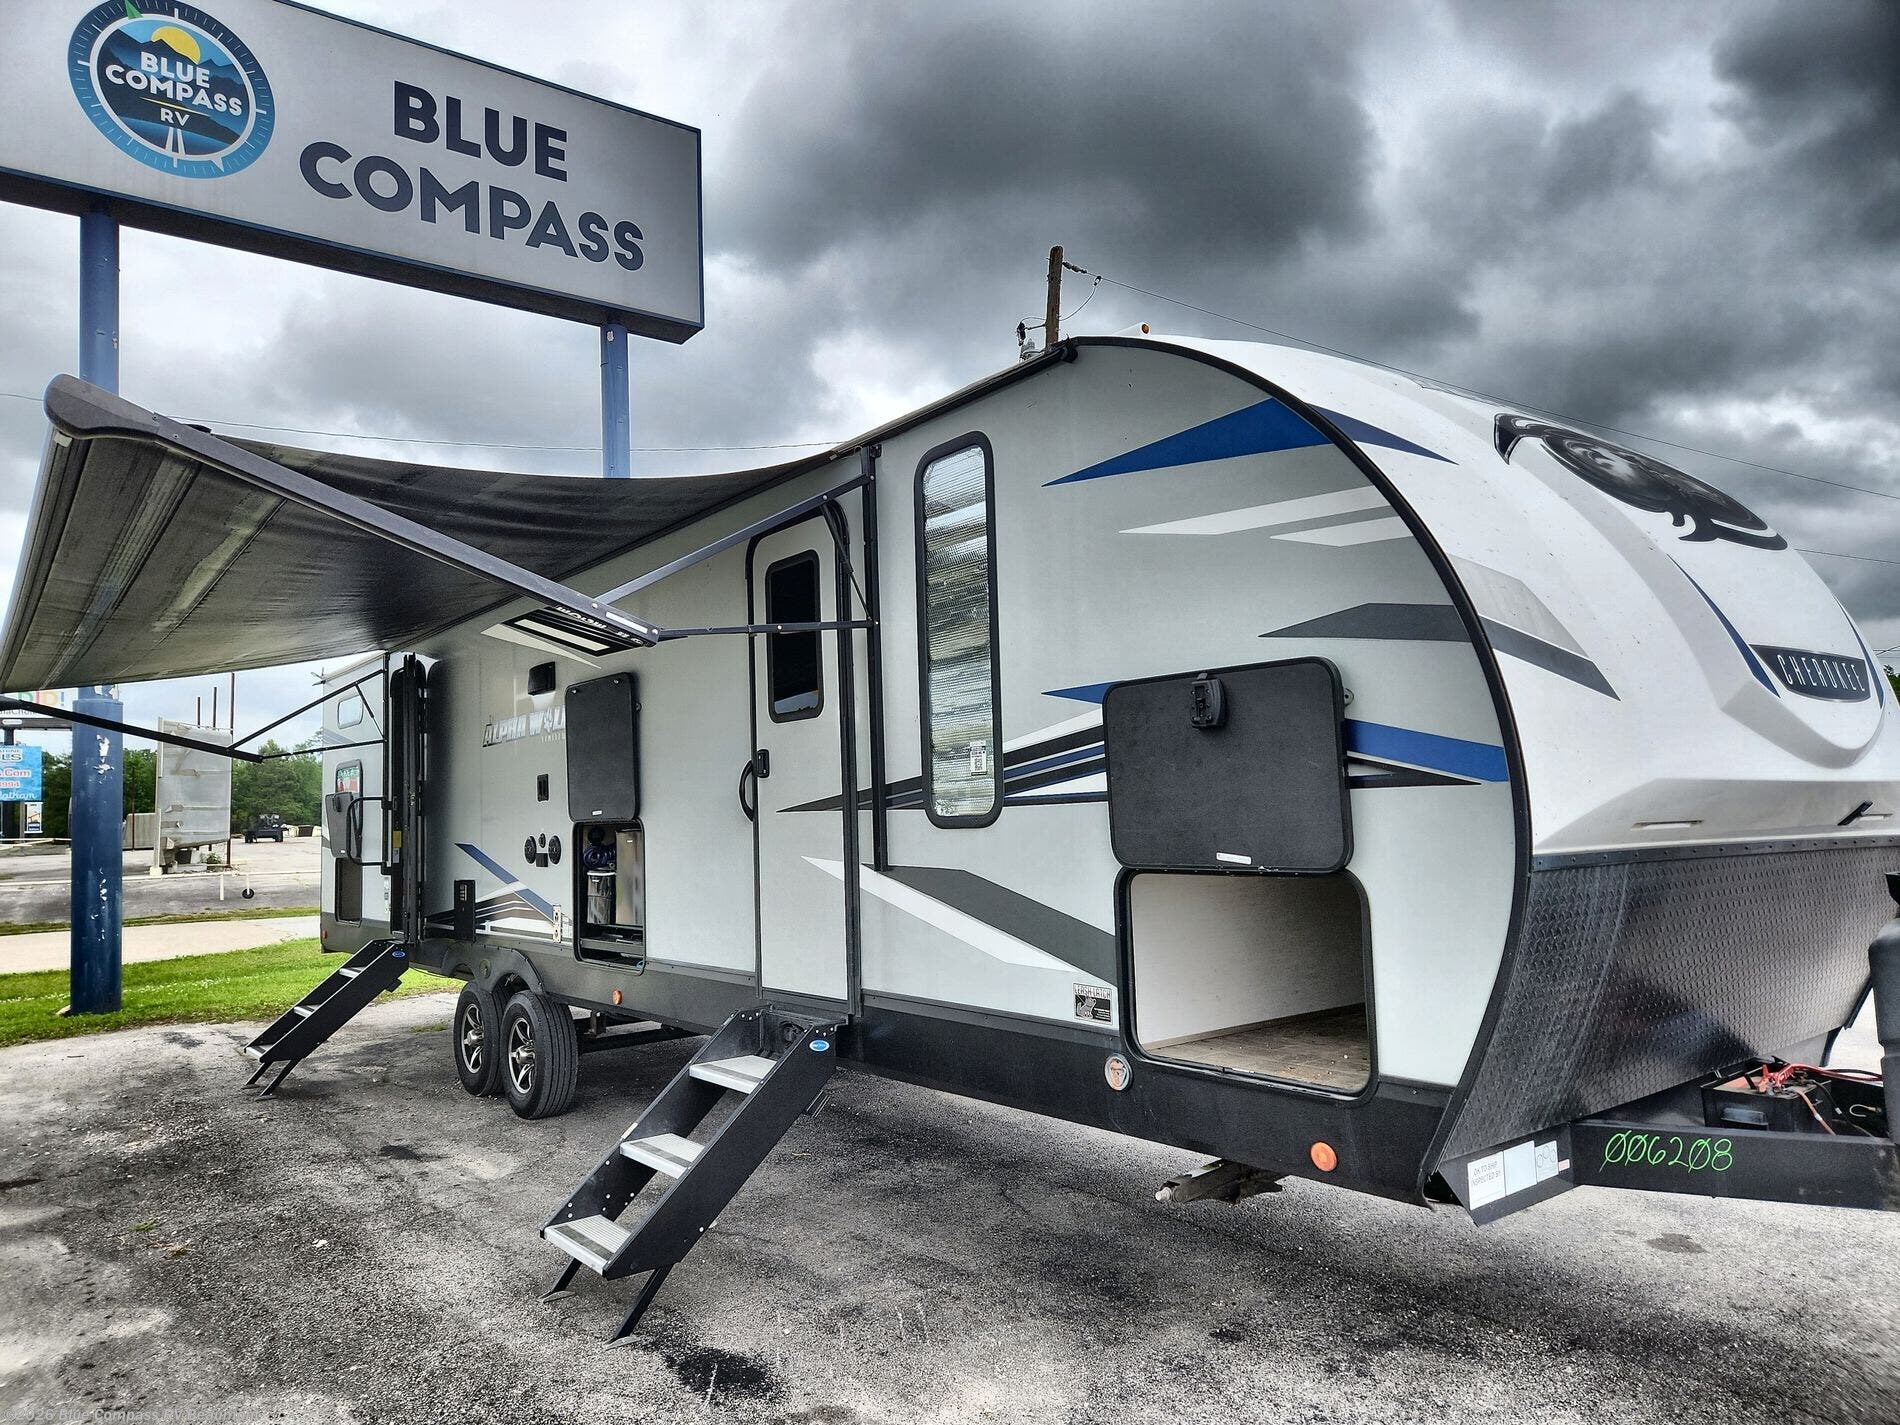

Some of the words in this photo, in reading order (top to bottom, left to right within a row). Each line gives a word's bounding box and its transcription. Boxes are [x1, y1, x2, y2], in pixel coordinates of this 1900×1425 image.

[141, 52, 210, 88] BLUE
[105, 64, 243, 116] COMPASS
[161, 107, 190, 127] RV
[394, 80, 568, 183] BLUE
[299, 141, 645, 271] COMPASS
[1777, 654, 1865, 692] CHEROKEE
[482, 714, 527, 748] ALPHA
